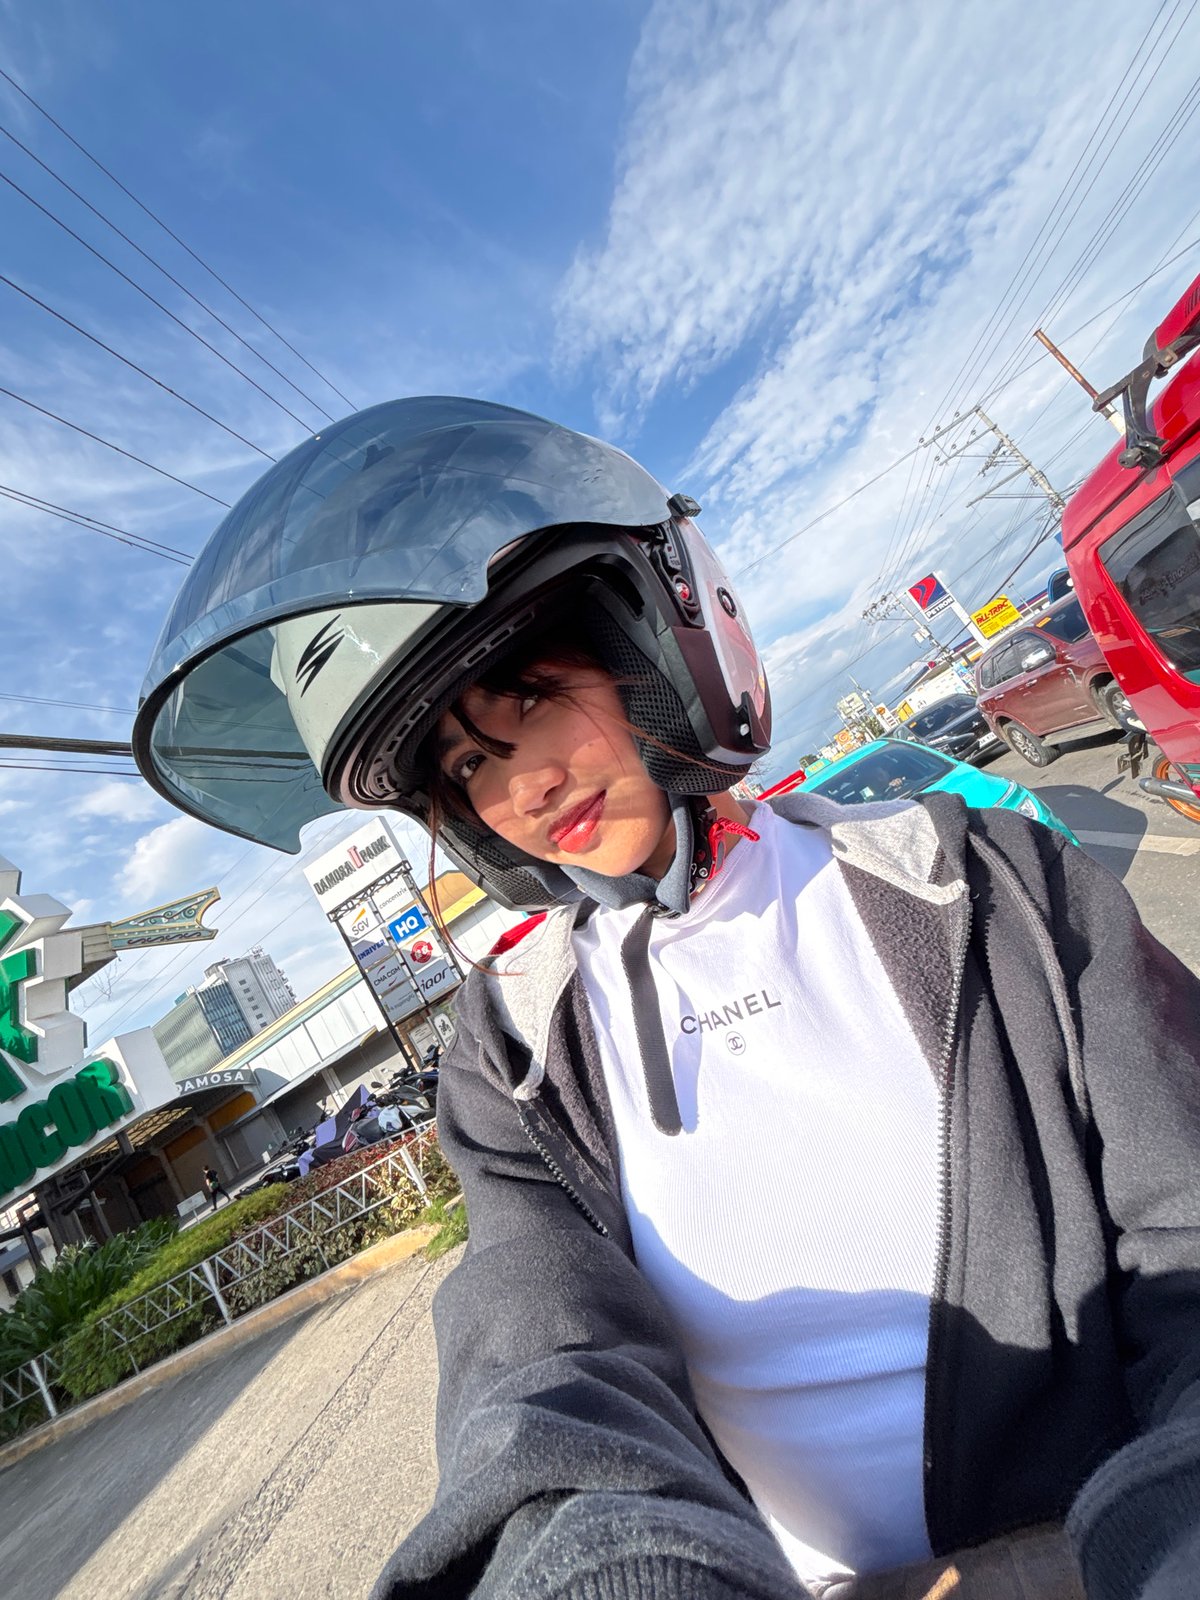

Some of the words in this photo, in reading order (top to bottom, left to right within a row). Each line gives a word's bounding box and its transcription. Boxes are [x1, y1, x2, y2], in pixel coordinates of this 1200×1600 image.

[927, 596, 955, 618] PETRON
[313, 860, 357, 896] DAMOSA
[359, 835, 391, 863] PARK
[351, 918, 370, 936] SGV
[395, 915, 419, 938] HQ
[373, 974, 388, 986] CMA
[386, 966, 400, 978] CGM
[680, 989, 782, 1035] CHANEL
